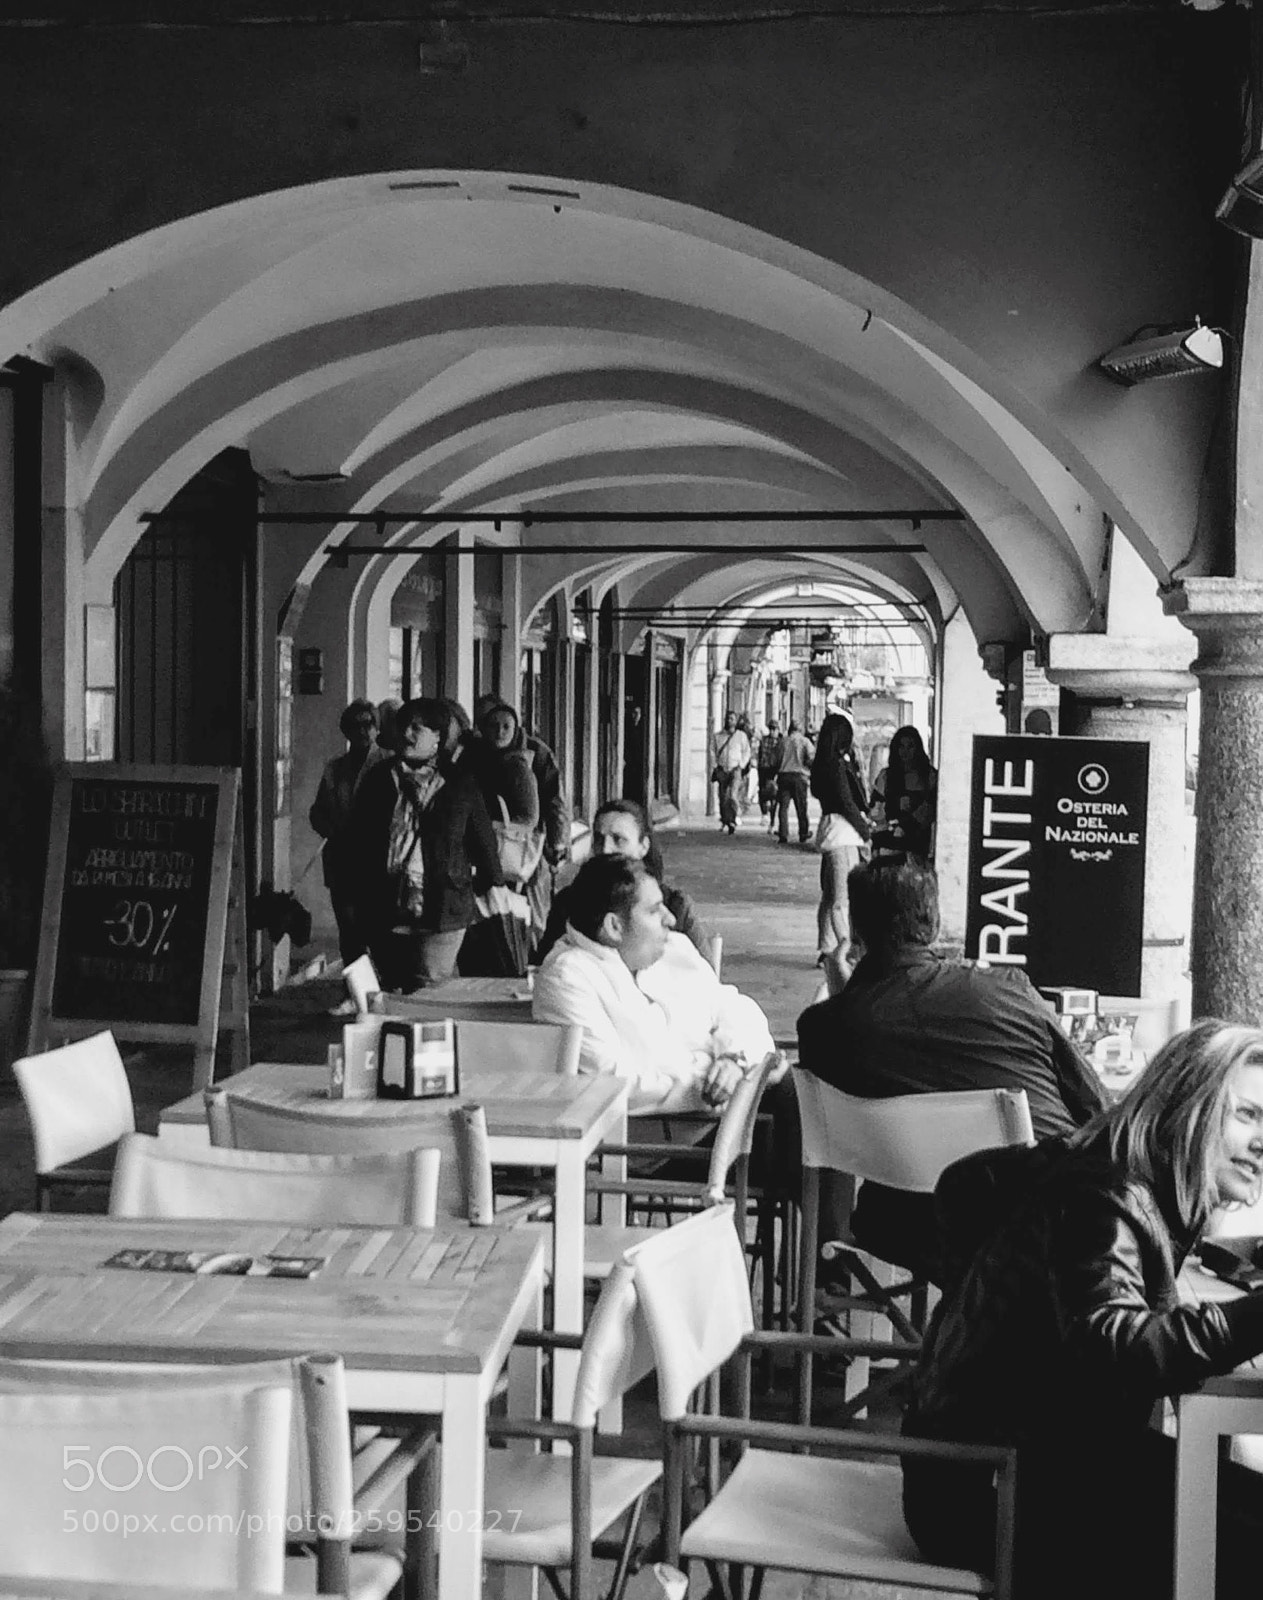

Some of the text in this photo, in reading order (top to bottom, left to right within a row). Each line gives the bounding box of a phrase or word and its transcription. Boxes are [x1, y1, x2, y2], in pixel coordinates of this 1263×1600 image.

[1057, 798, 1129, 816] OSTERIA
[1076, 816, 1108, 829] DEL
[1045, 825, 1140, 845] NAZIONALE
[979, 758, 1034, 965] RANTE
